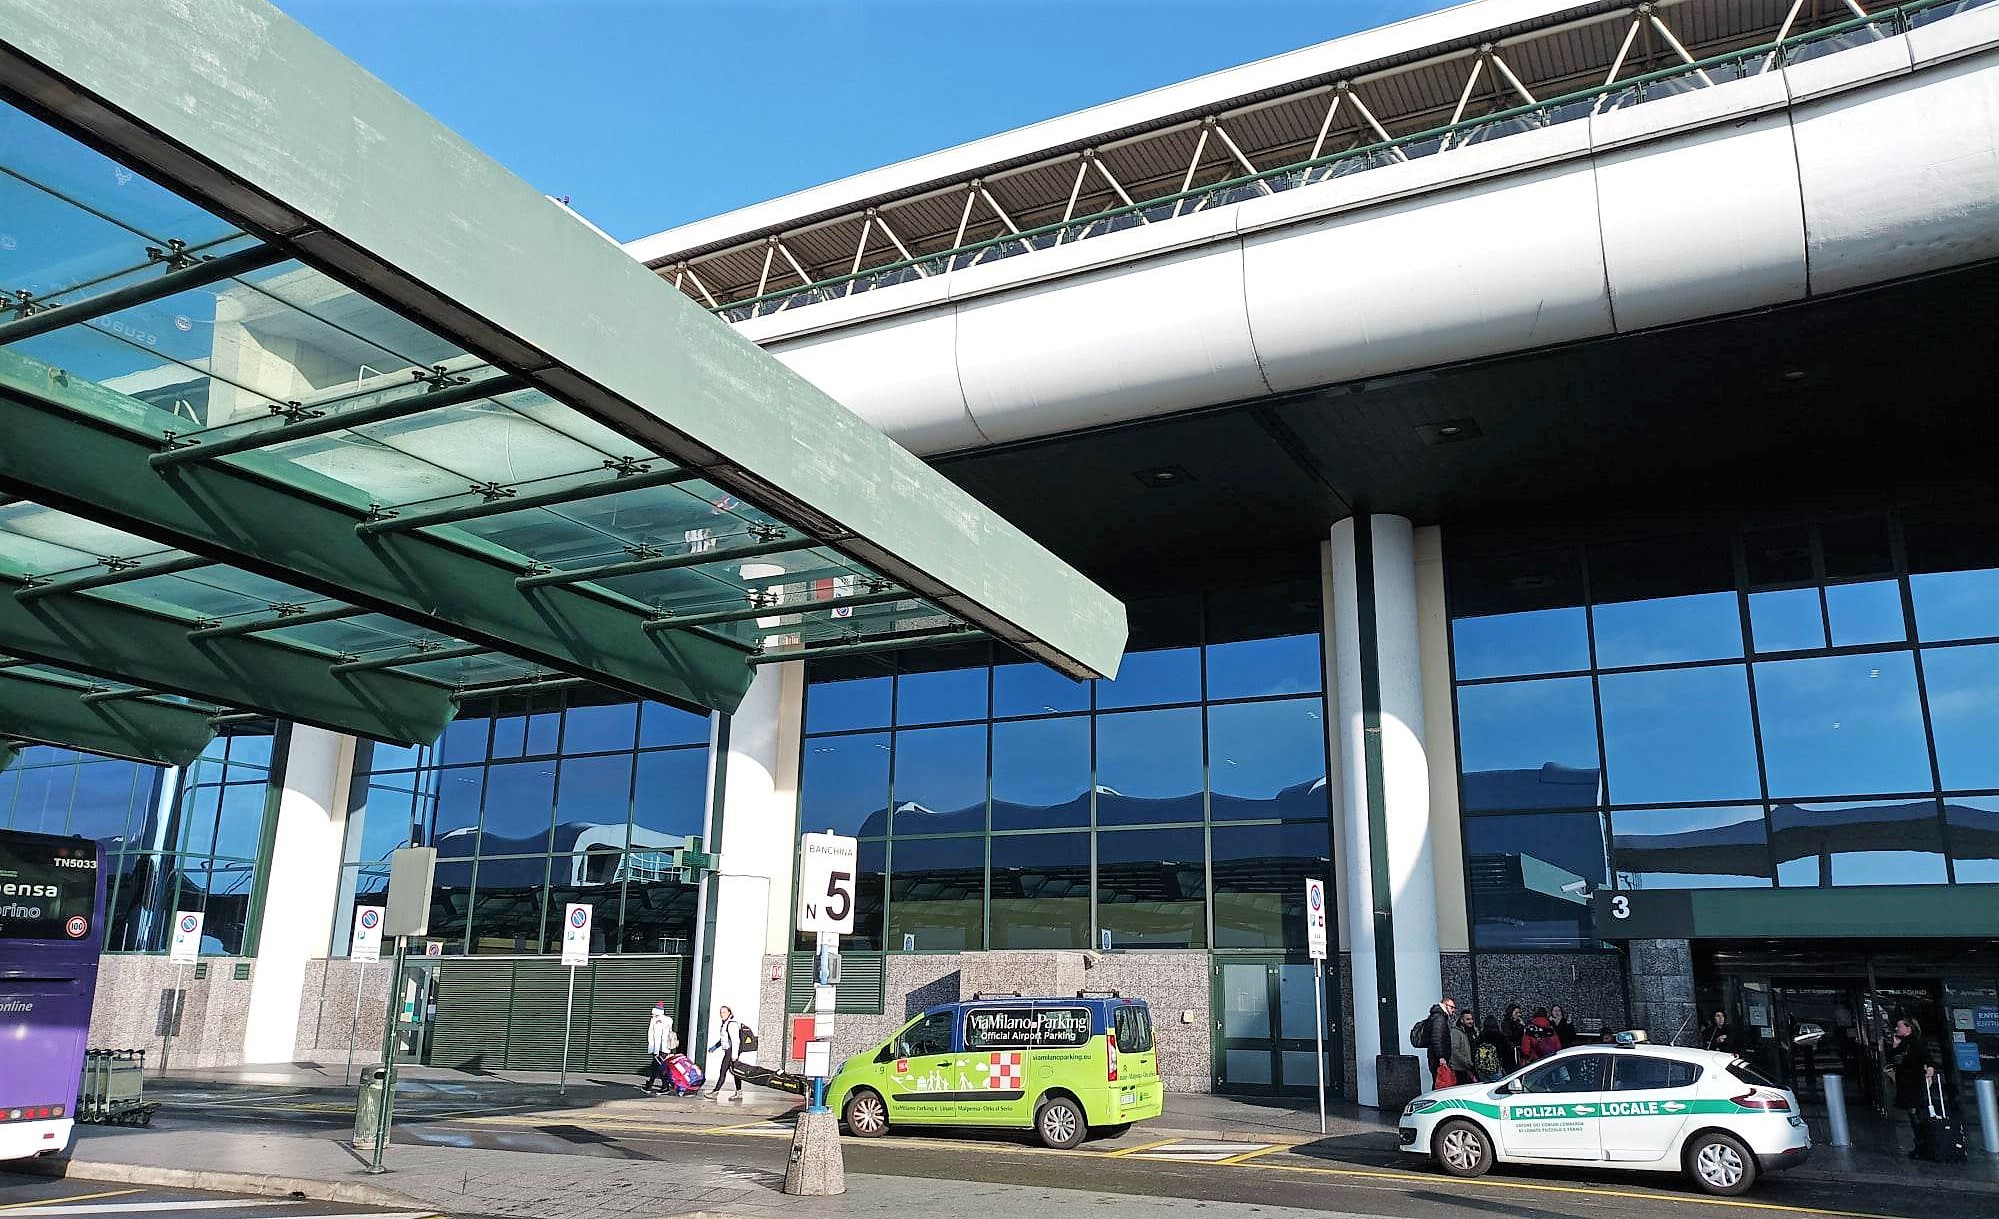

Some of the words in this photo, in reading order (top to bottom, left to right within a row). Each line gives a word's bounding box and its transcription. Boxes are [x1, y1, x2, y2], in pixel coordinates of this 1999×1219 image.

[809, 844, 853, 857] BANCHINA
[54, 857, 97, 869] TN5033
[0, 883, 58, 898] ensa
[806, 903, 816, 920] N
[825, 871, 851, 921] 5
[1612, 895, 1630, 919] 3
[71, 922, 84, 930] 100
[970, 1013, 1032, 1030] ViaMilano
[1037, 1012, 1087, 1033] Parking
[981, 1031, 1010, 1041] Official
[1012, 1031, 1041, 1043] Airport
[1044, 1031, 1076, 1042] Parking
[1032, 1053, 1092, 1062] viamilanoparking.eu
[1515, 1107, 1566, 1118] POLIZIA
[1601, 1102, 1659, 1116] LOCALE
